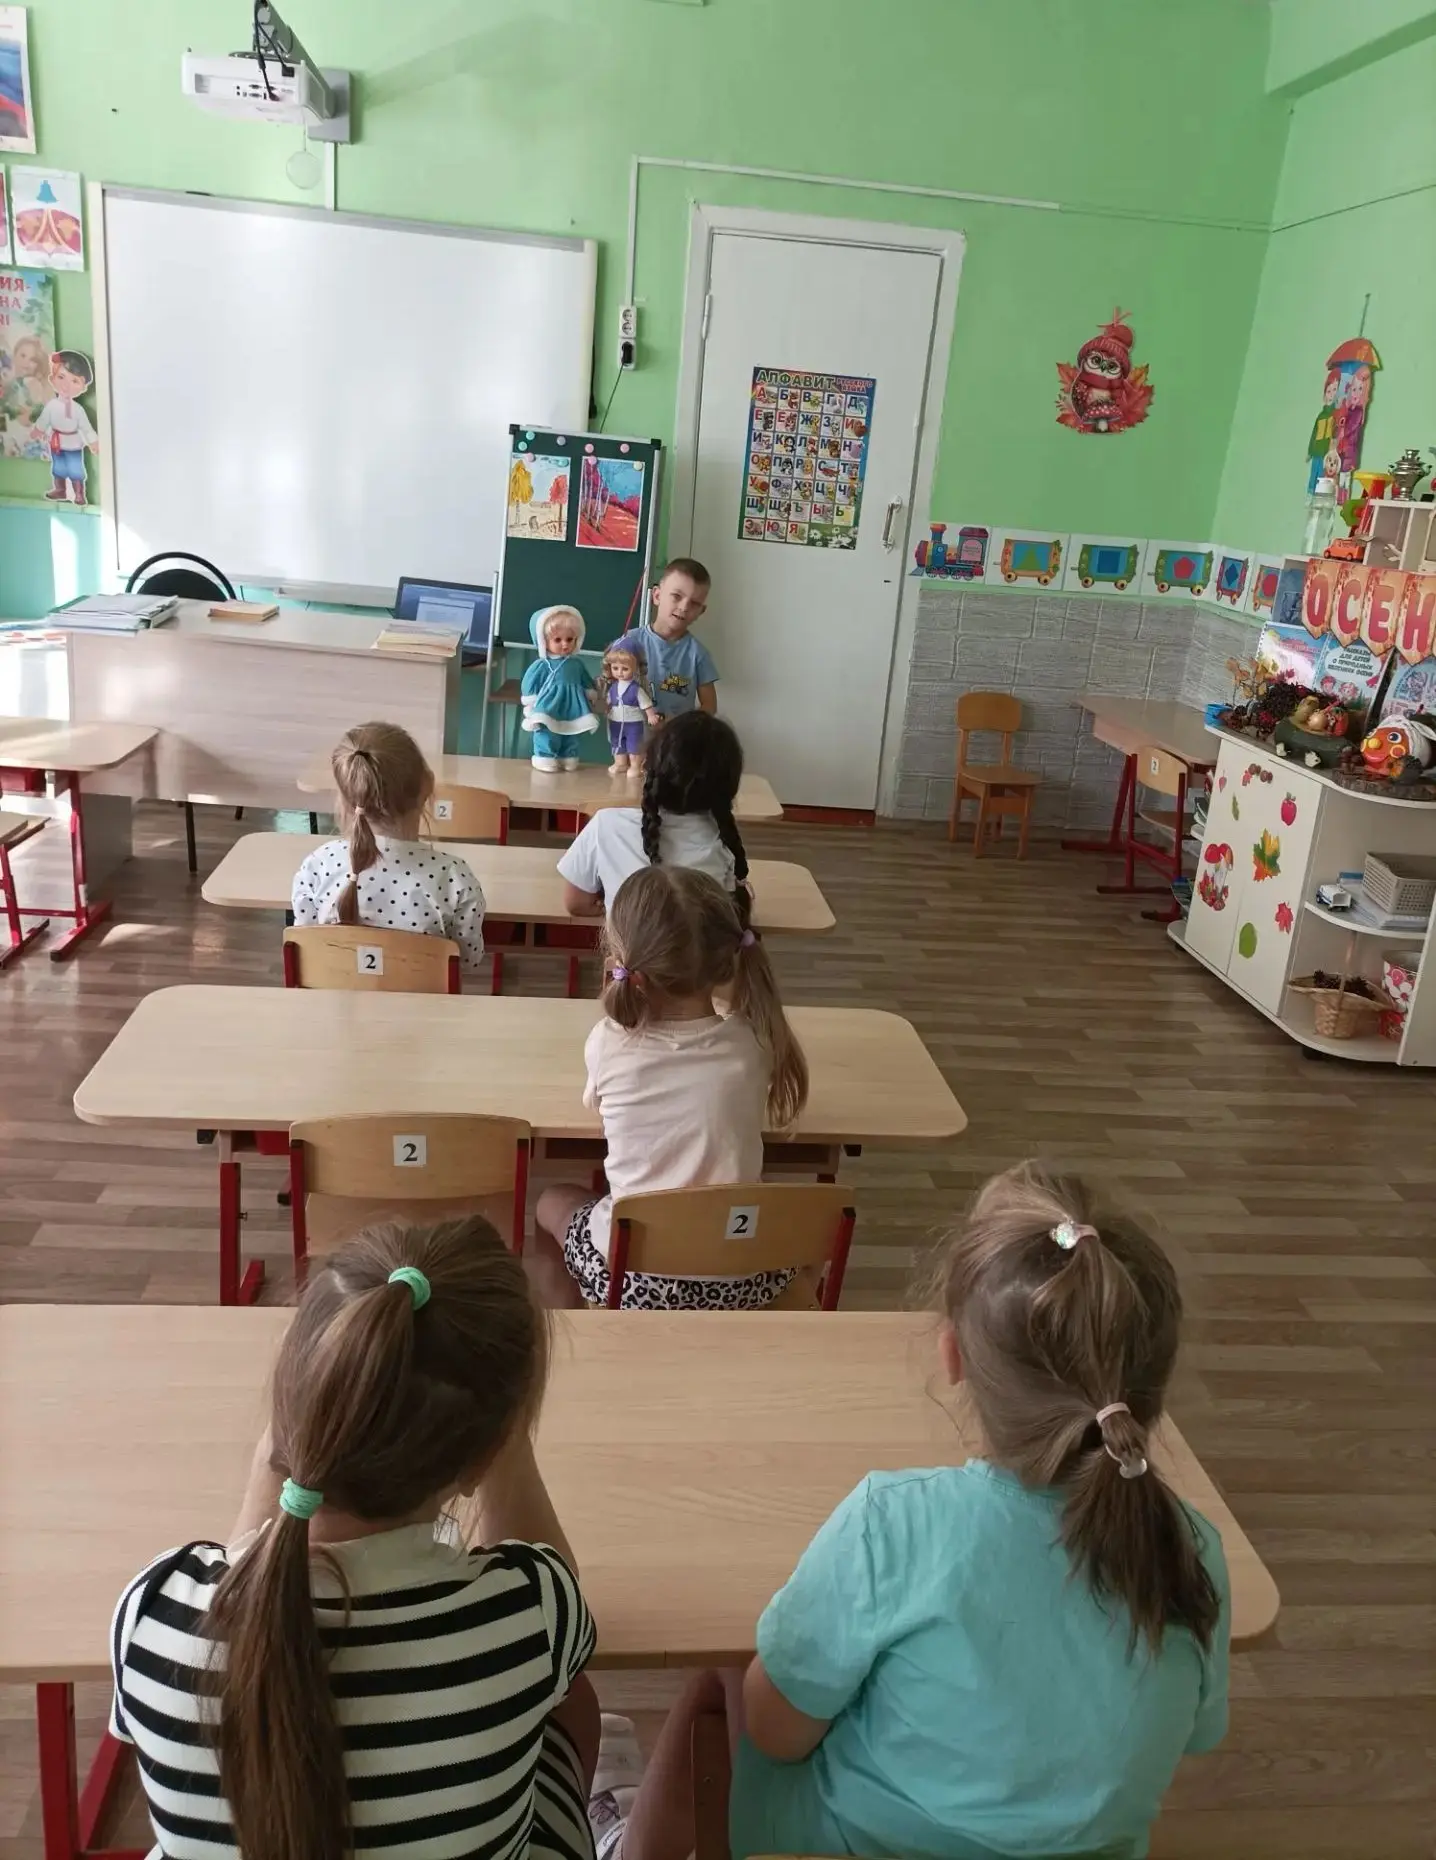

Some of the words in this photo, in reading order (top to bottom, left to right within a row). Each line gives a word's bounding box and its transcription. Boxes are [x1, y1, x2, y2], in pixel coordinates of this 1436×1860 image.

[756, 369, 835, 390] АЛФАВИТ
[756, 386, 767, 399] А
[780, 388, 789, 400] Б
[803, 391, 811, 403] В
[826, 394, 835, 405] Г
[847, 396, 857, 409] Д
[754, 409, 763, 421] Е
[800, 413, 813, 425] Ж
[823, 416, 831, 428] З
[775, 434, 784, 445] К
[798, 436, 808, 448] Л
[820, 438, 831, 450] М
[842, 440, 852, 452] Н
[751, 453, 759, 465] О
[772, 456, 782, 467] П
[795, 458, 804, 469] Р
[817, 460, 827, 472] С
[840, 462, 849, 473] Т
[749, 475, 757, 487] У
[771, 478, 782, 489] Ф
[793, 480, 803, 492] Х
[815, 482, 825, 495] Ц
[838, 484, 847, 495] Ч
[746, 497, 758, 508] Ш
[813, 504, 825, 515] Ы
[835, 506, 844, 517] Ь
[766, 521, 779, 532] Ю
[789, 523, 798, 534] Я
[364, 954, 376, 970] 2
[403, 1143, 418, 1162] 2
[733, 1214, 749, 1234] 2
